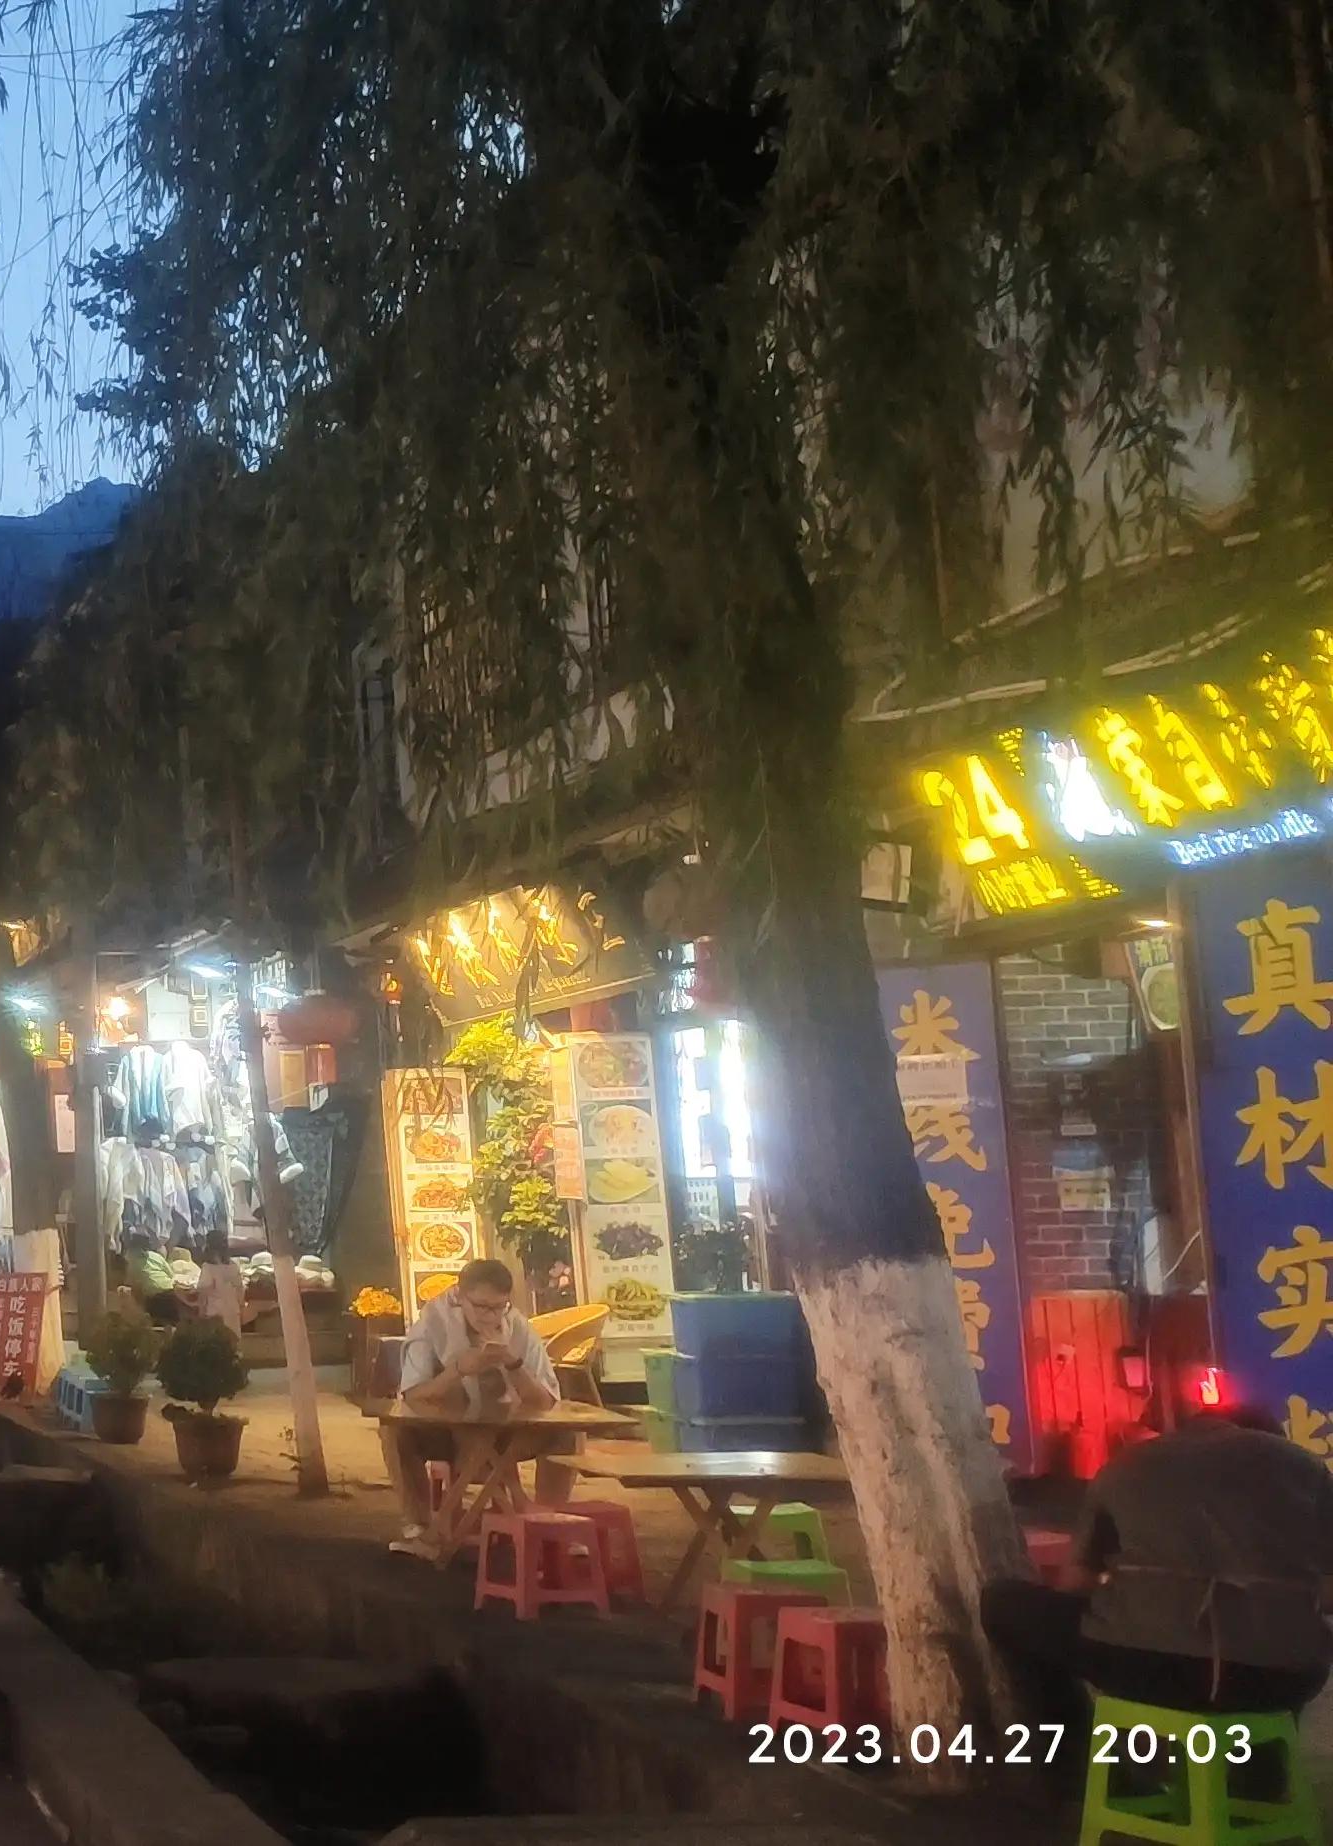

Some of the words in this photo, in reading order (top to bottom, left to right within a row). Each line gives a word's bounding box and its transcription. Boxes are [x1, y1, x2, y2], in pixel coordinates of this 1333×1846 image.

[922, 754, 1030, 866] 24
[891, 989, 1012, 1444] 米线免
[2, 1296, 27, 1377] 吃饭停车
